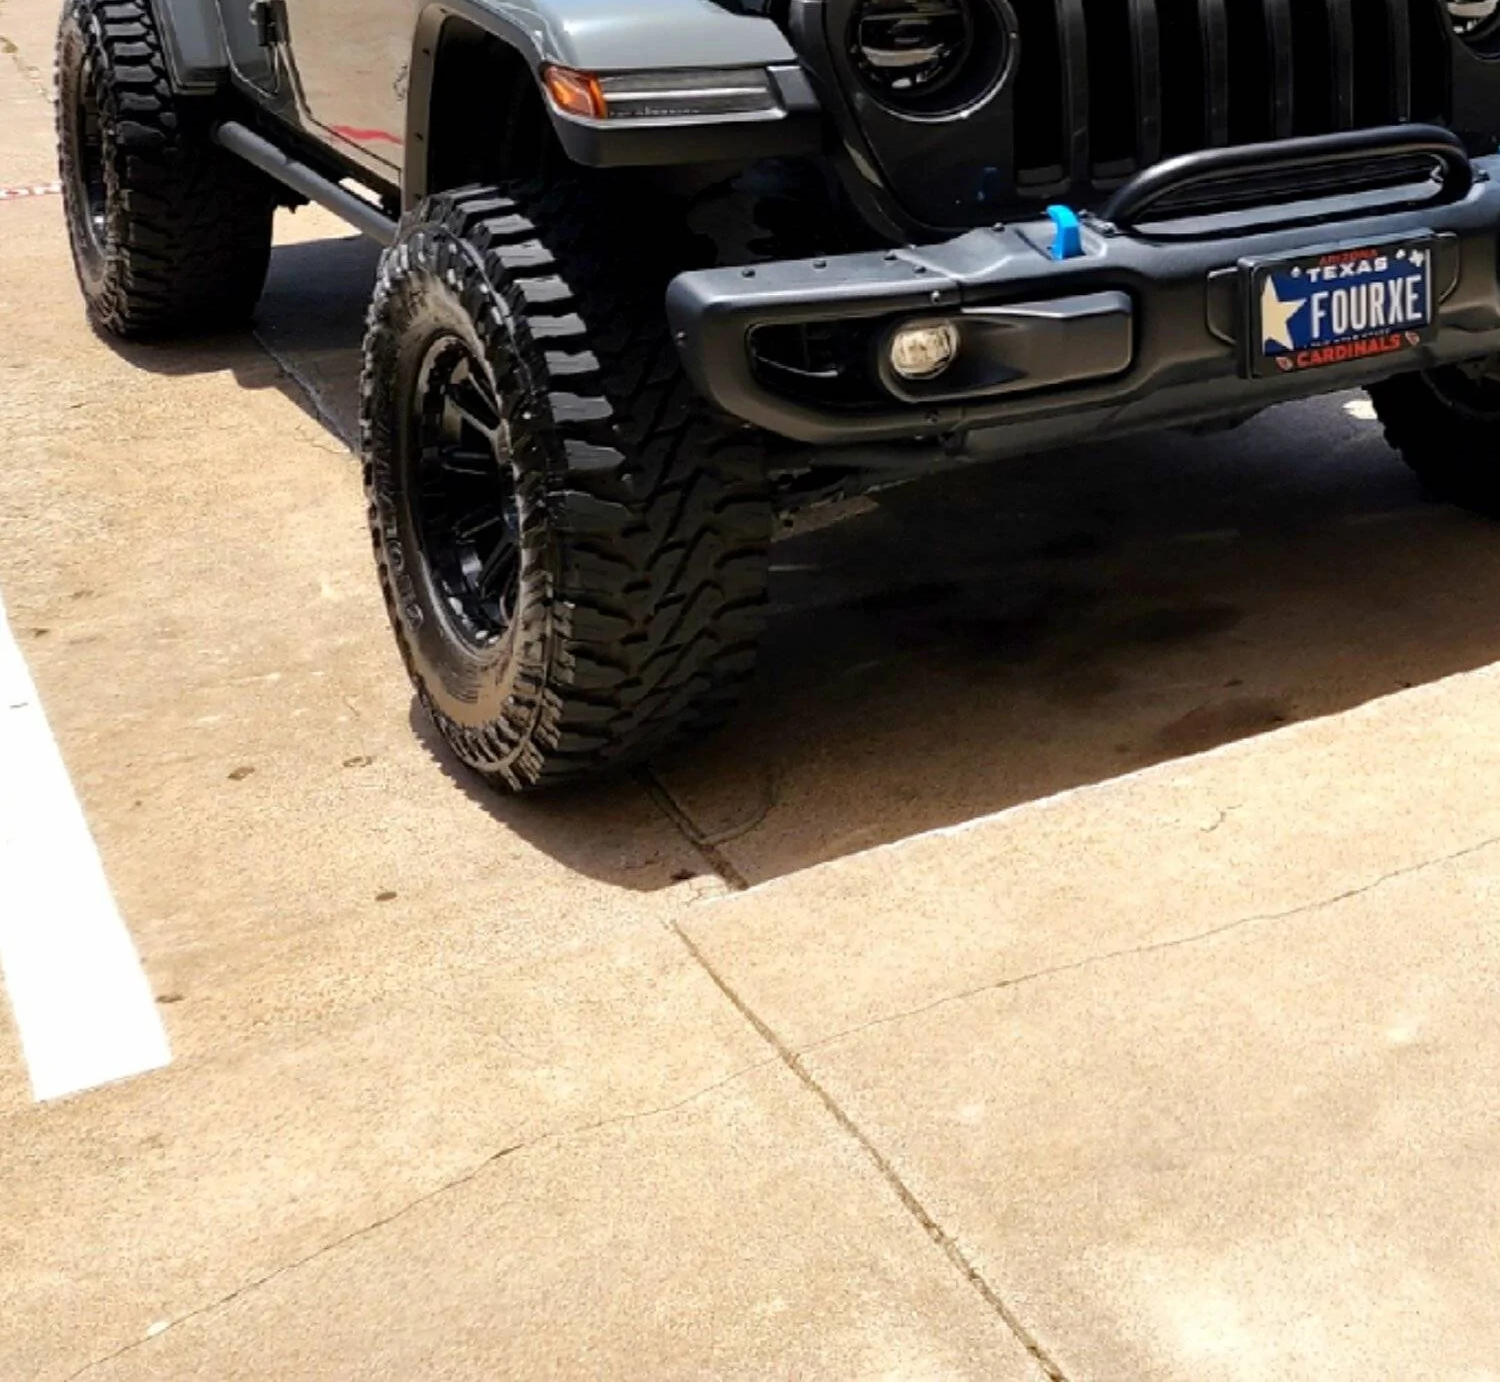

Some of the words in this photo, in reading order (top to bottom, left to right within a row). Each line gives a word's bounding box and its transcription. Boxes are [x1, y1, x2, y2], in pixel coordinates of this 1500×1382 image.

[1306, 256, 1388, 283] TEXAS
[1310, 274, 1422, 339] FOURXE
[1296, 333, 1401, 367] CARDINALS
